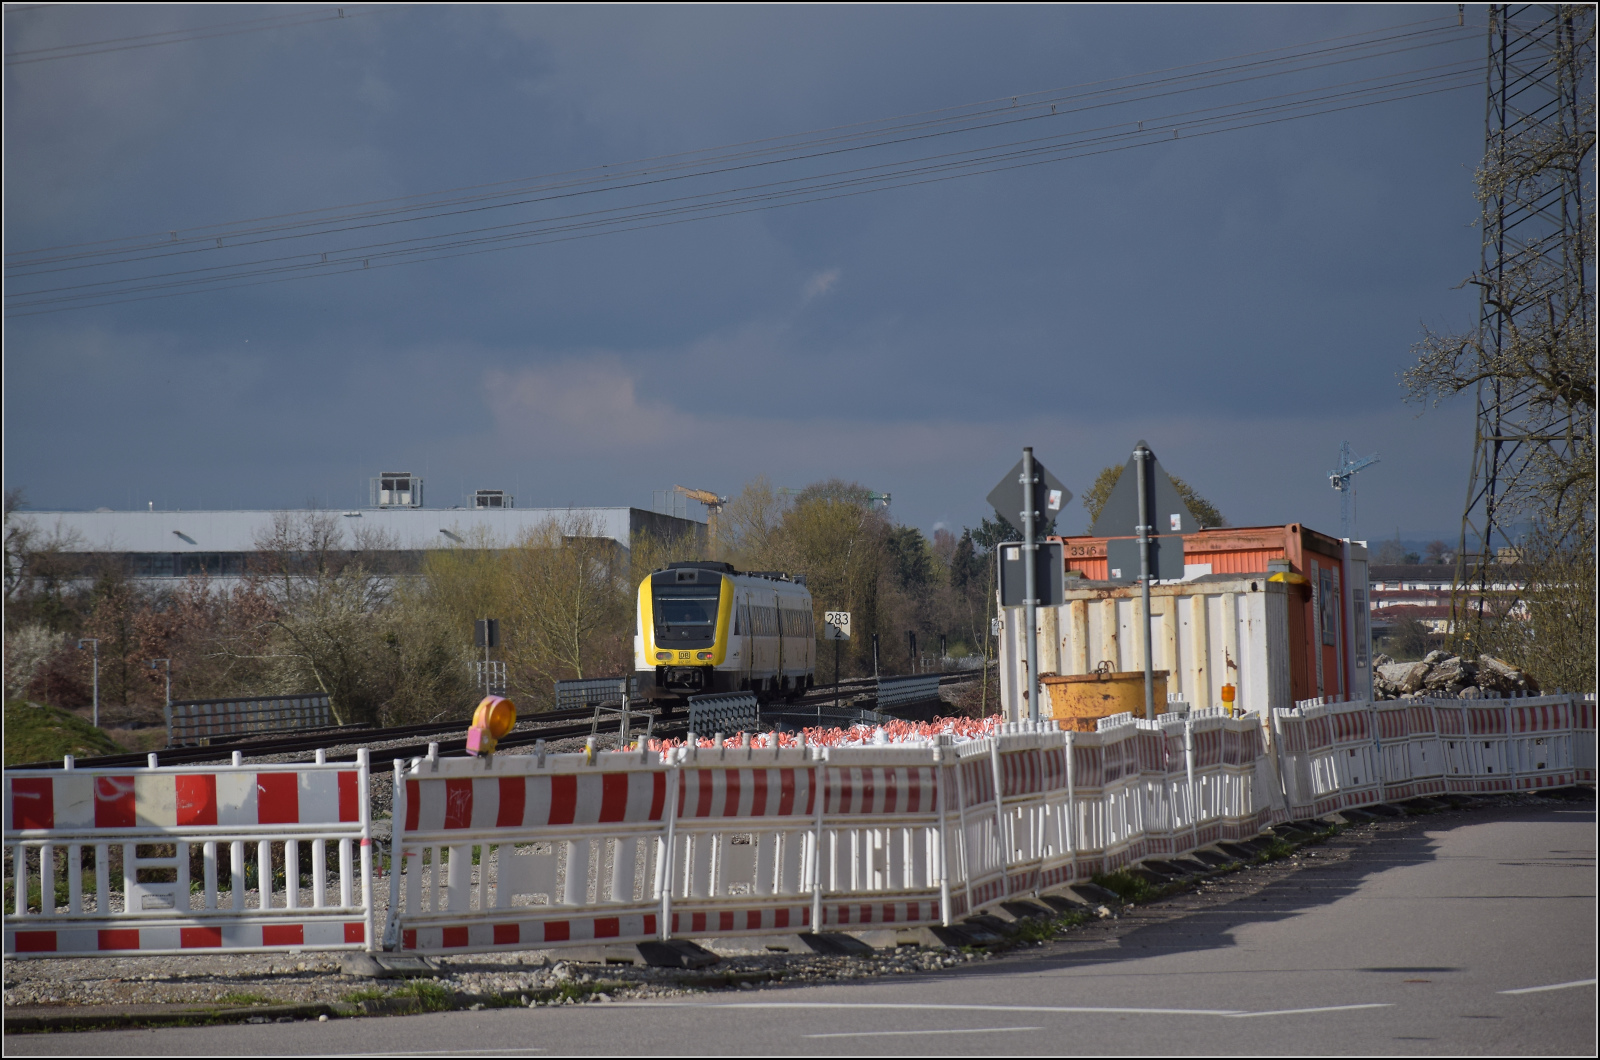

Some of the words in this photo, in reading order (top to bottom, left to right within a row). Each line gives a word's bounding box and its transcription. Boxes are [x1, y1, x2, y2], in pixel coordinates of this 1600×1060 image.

[827, 613, 849, 625] 283
[834, 626, 841, 638] 2
[679, 651, 690, 659] DB
